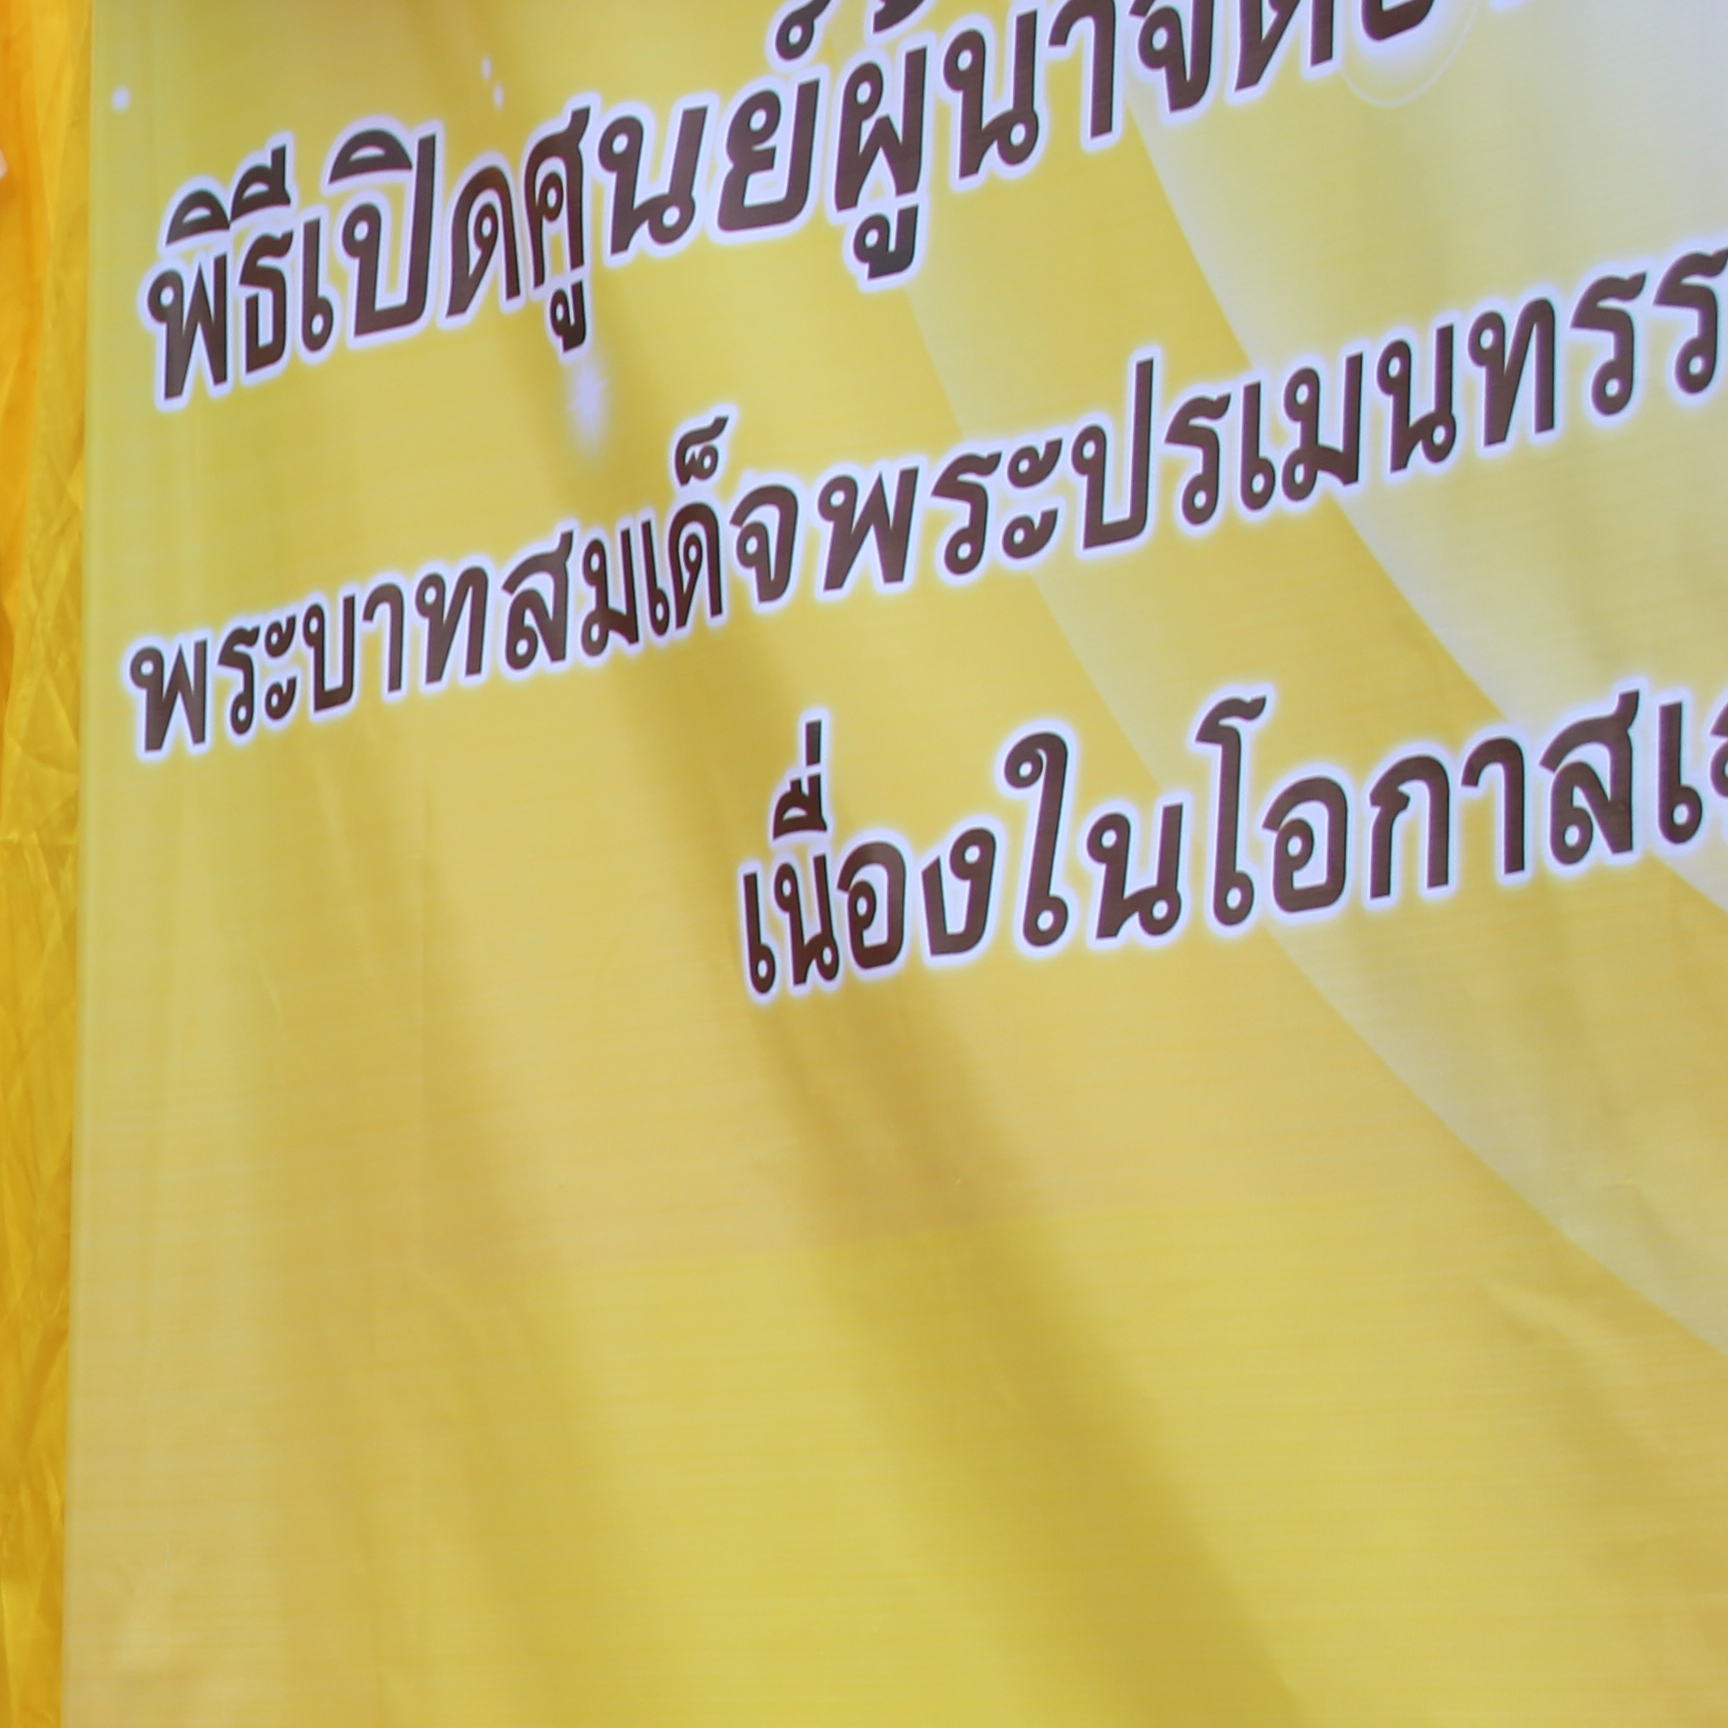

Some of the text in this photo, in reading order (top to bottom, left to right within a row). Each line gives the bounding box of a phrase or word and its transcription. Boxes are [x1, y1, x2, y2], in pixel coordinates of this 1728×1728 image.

[129, 247, 1728, 752] พระบาทสมเด็จพระปรเมนทรร
[741, 689, 1728, 995] เนื่องในโอกาสเ
